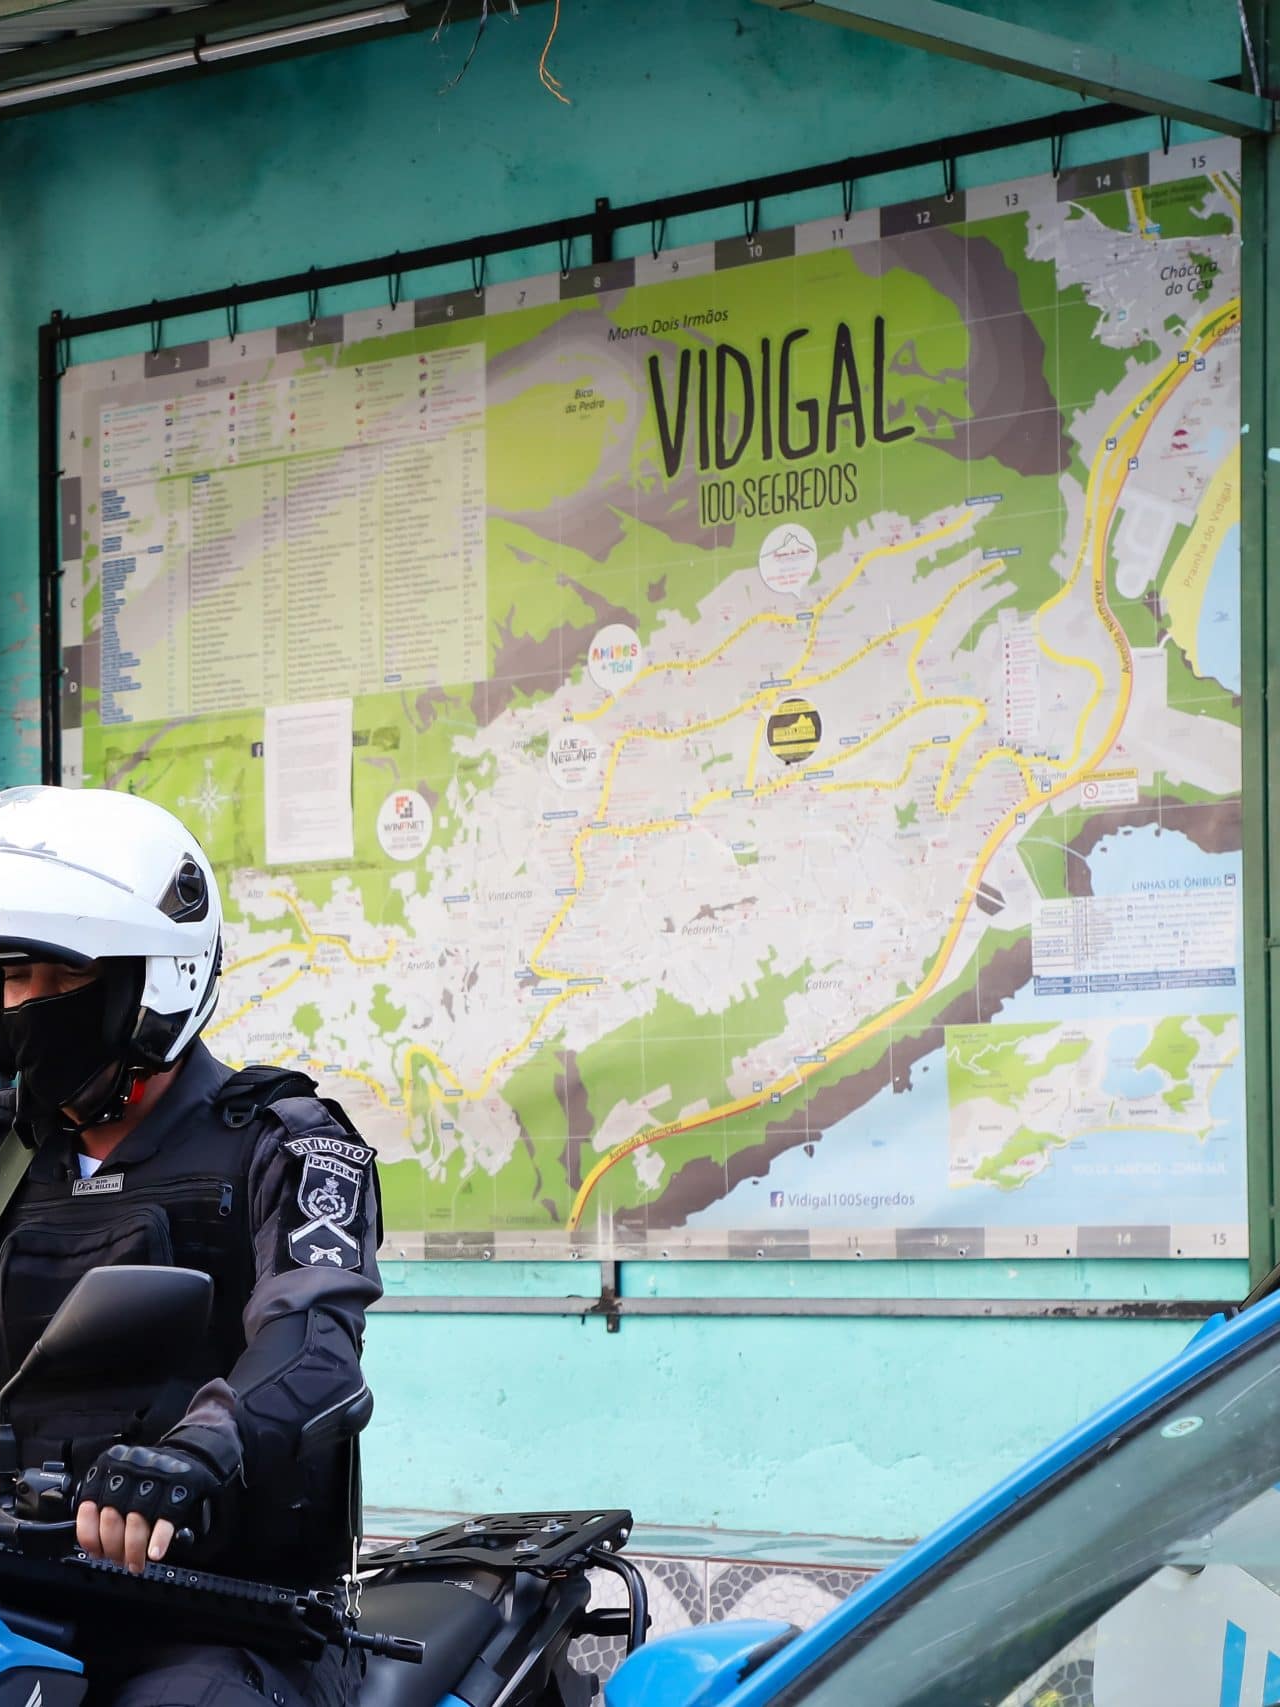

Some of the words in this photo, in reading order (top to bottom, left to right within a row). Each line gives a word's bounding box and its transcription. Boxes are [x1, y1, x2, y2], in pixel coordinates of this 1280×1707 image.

[376, 319, 384, 331] 5
[446, 305, 455, 317] 6
[592, 276, 602, 289] 8
[672, 260, 680, 273] 9
[748, 244, 763, 259] 10
[831, 228, 845, 241] 11
[916, 211, 931, 225] 12
[1004, 193, 1019, 207] 13
[1095, 174, 1111, 188] 14
[1190, 155, 1207, 169] 15
[1165, 283, 1183, 297] do
[651, 318, 680, 334] Dois
[682, 308, 729, 329] Irmãos
[648, 315, 916, 478] VIDIGAL
[700, 478, 737, 526] 100
[743, 462, 859, 519] SEGREDOS
[1131, 879, 1167, 891] LINHAS
[1168, 878, 1182, 889] DE
[1184, 875, 1222, 888] ÔNIBUS
[788, 1191, 915, 1210] Vidigal100Segredos
[847, 1235, 860, 1248] 11
[1024, 1234, 1039, 1248] 13
[1116, 1233, 1132, 1247] 14
[1212, 1233, 1227, 1247] 15
